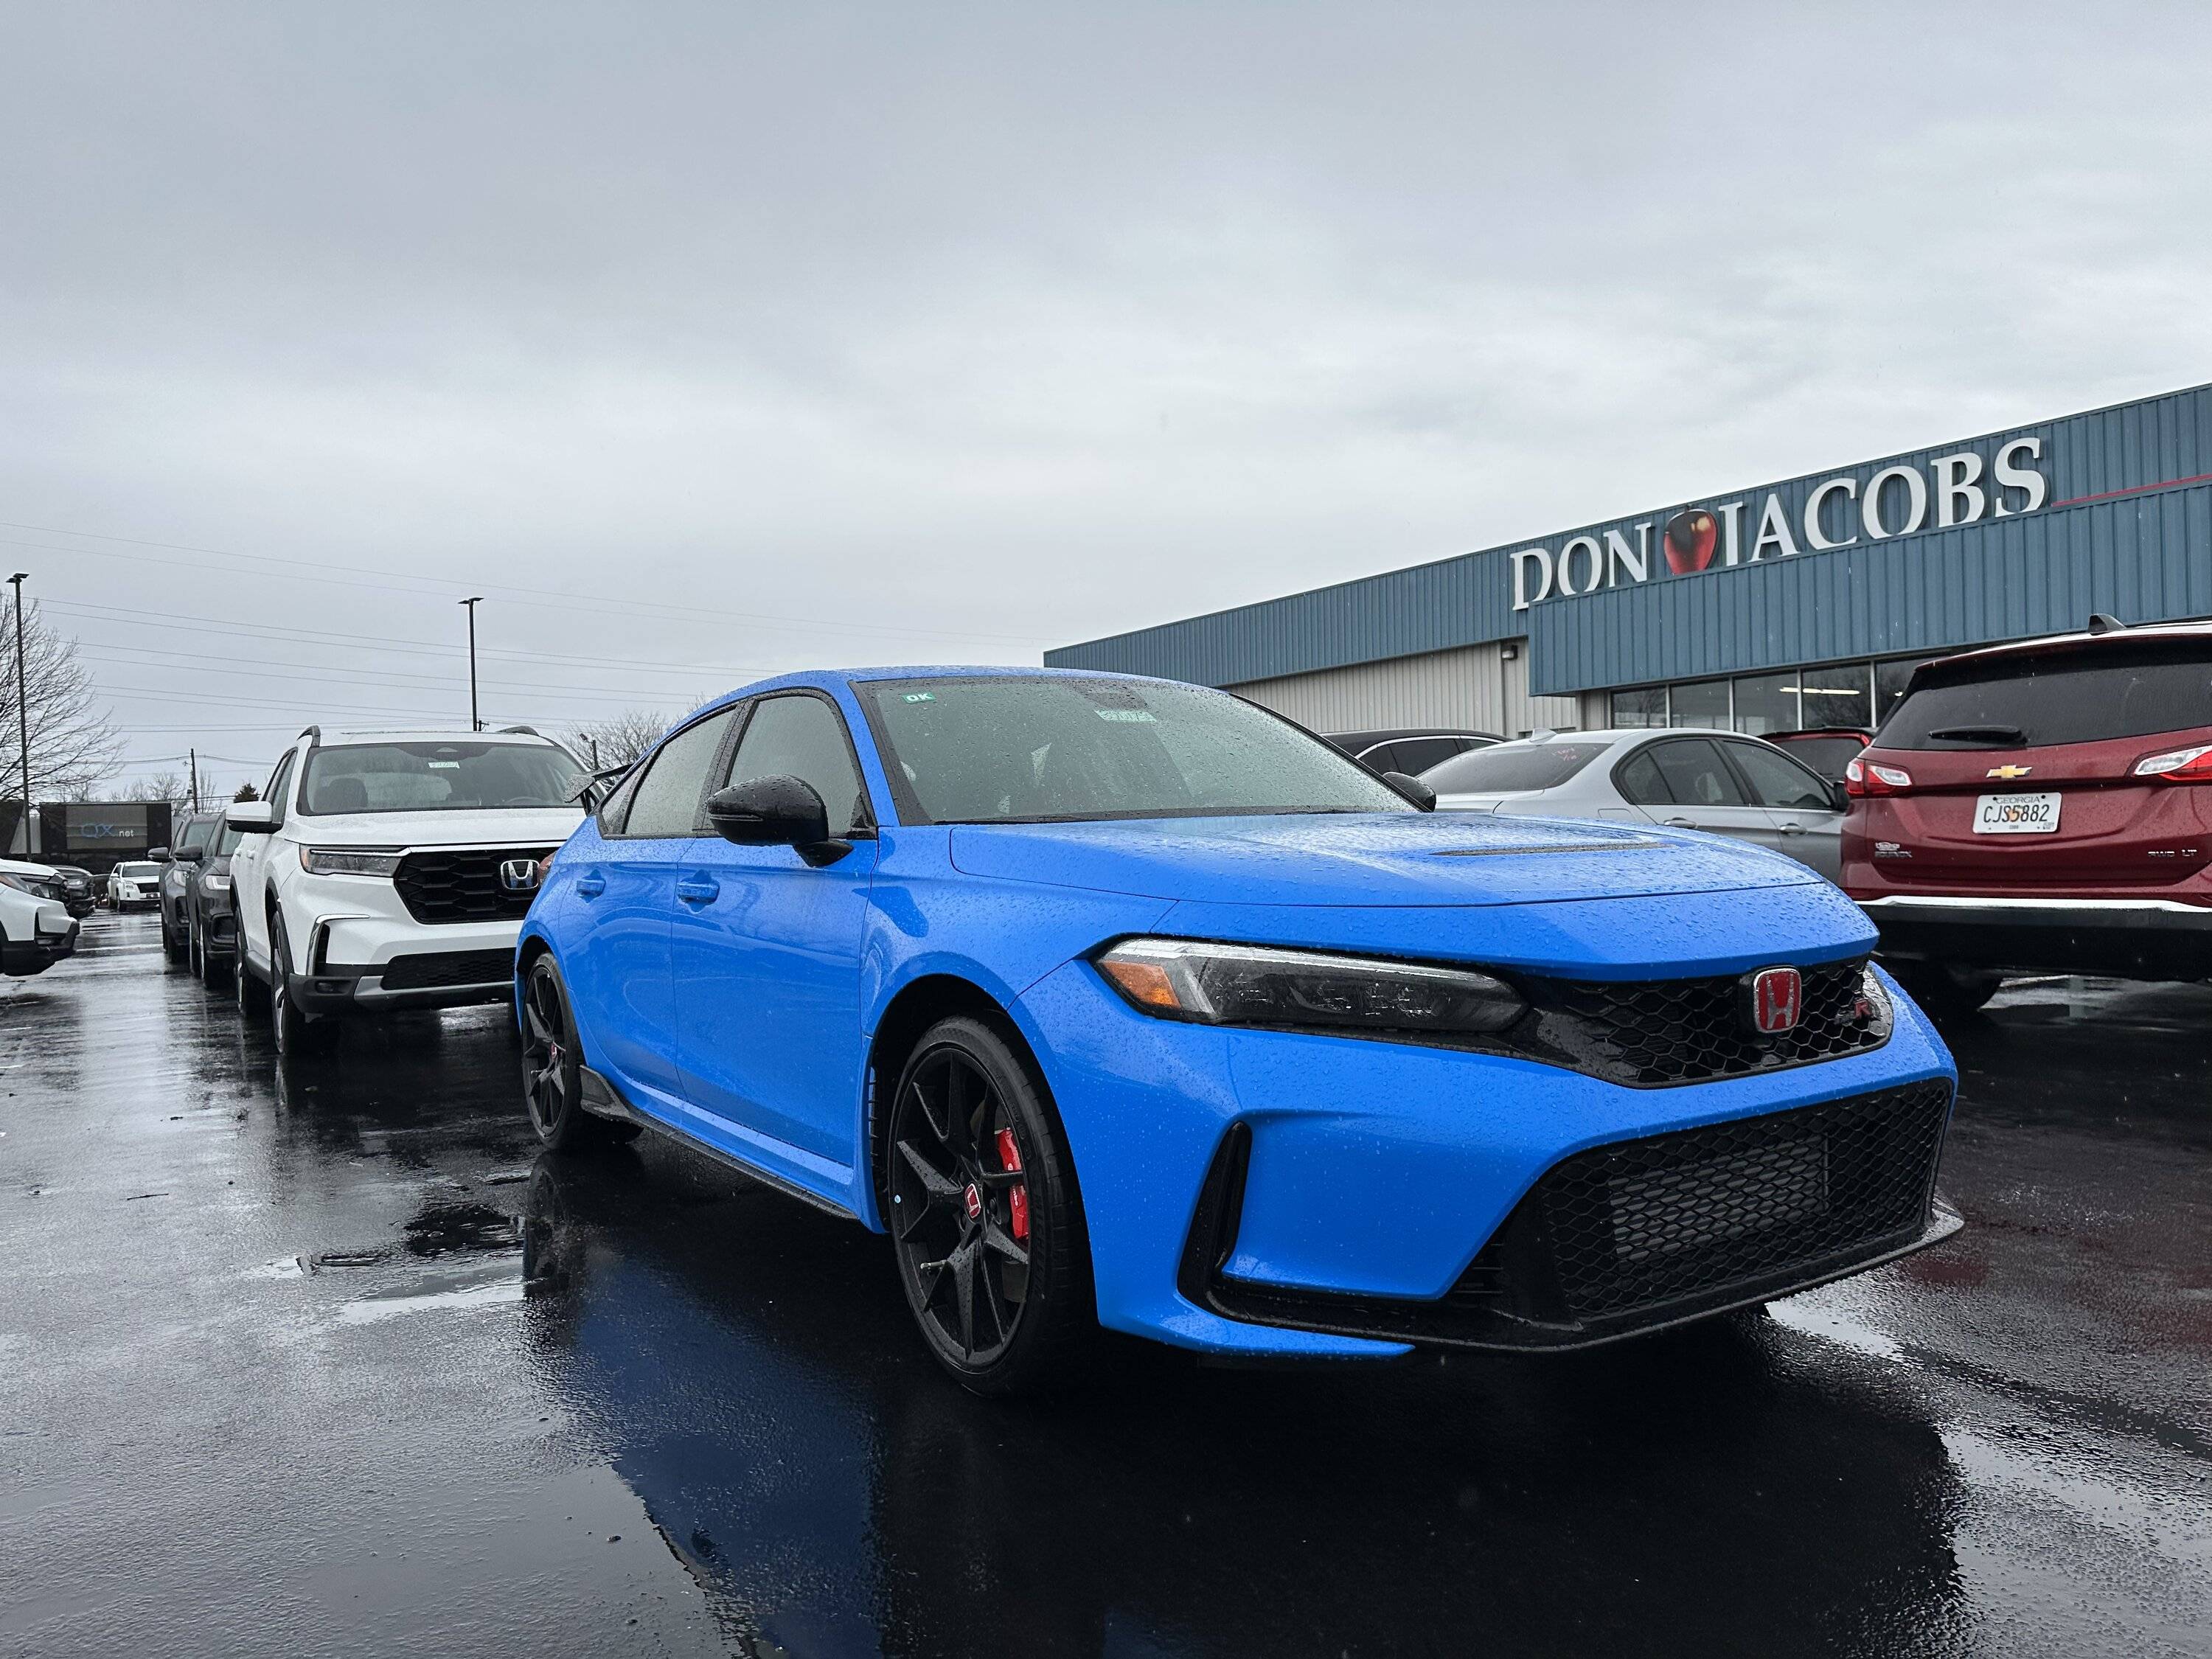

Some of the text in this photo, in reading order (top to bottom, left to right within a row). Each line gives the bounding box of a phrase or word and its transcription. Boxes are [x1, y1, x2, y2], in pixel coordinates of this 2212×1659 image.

[1509, 521, 1652, 611] DON
[905, 692, 933, 701] OK
[1995, 796, 2041, 804] GEORGIA
[1983, 804, 2050, 823] CJS5882
